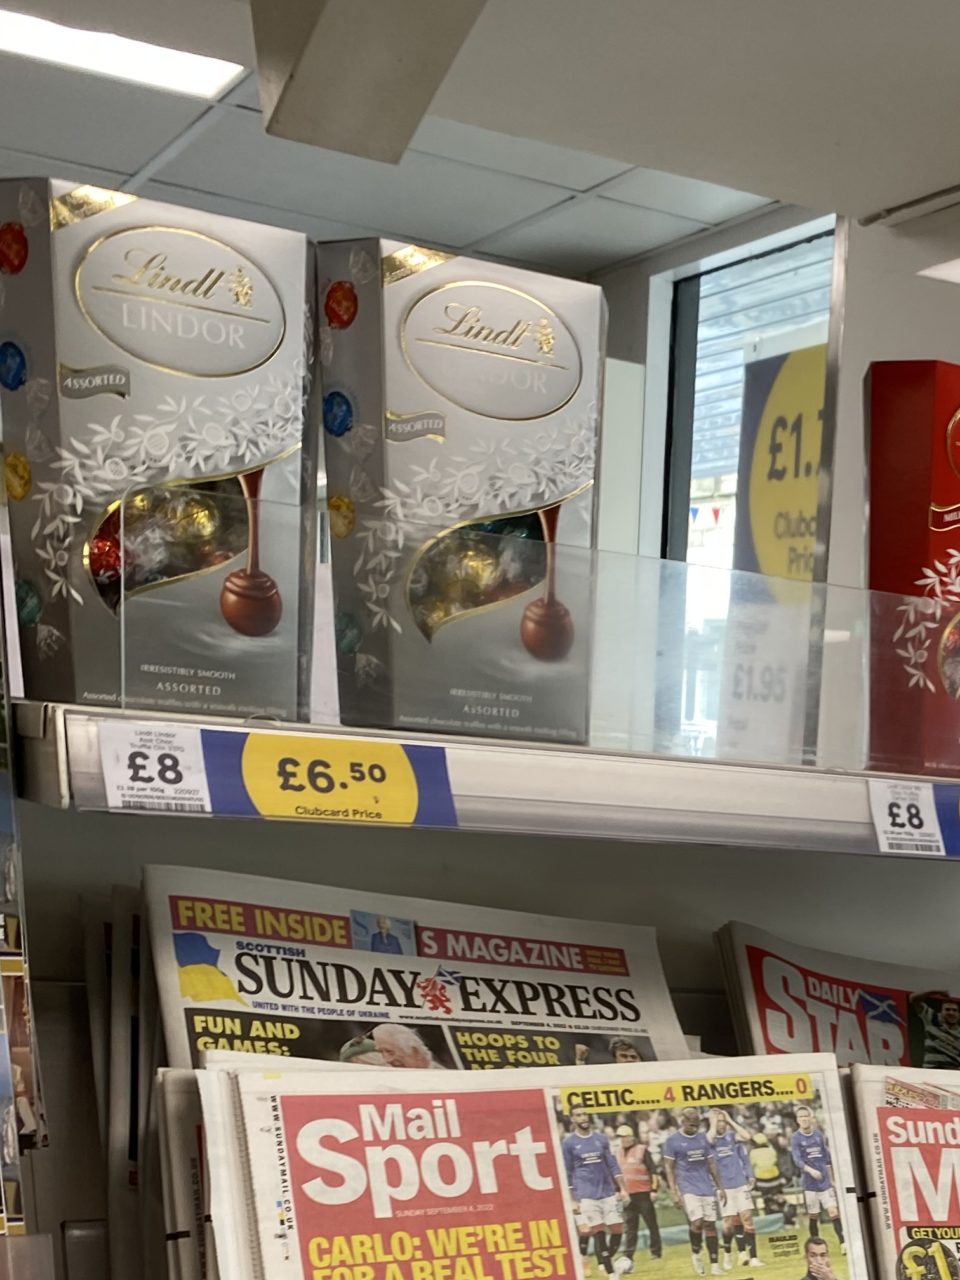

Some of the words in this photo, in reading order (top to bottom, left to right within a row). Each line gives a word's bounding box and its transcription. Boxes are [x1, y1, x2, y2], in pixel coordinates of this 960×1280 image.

[112, 247, 226, 300] Lindt
[122, 303, 245, 349] LINDOR
[432, 302, 532, 349] Lindt
[63, 374, 126, 389] ASSORTED
[140, 664, 195, 676] IRRESISTIBLY
[197, 668, 236, 680] SMOOTH
[156, 682, 222, 696] ASSORTED
[463, 704, 520, 718] ASSORTED
[127, 751, 183, 785] £8
[277, 757, 387, 794] £6.50
[295, 805, 349, 818] Clubcard
[352, 809, 382, 820] Price
[888, 802, 924, 830] £8
[176, 900, 246, 934] FREE
[254, 909, 348, 945] INSIDE
[235, 941, 306, 958] SCOTTISH
[421, 930, 438, 956] S
[447, 933, 584, 970] MAGAZINE
[234, 952, 424, 1009] SUNDAY
[460, 976, 641, 1022] EXPRESS
[808, 980, 858, 1011] DAILY
[252, 1000, 280, 1011] UNITED
[281, 1003, 300, 1013] WITH
[302, 1006, 316, 1015] THE
[317, 1007, 346, 1017] PEOPLE
[347, 1009, 356, 1018] OF
[358, 1010, 390, 1020] UKRAINE
[762, 955, 905, 1067] STAR
[193, 1015, 242, 1036] FUN
[250, 1021, 300, 1040] AND
[358, 1099, 462, 1141] Mail
[296, 1118, 555, 1219] Sport
[308, 1230, 423, 1269] CARLO:
[427, 1223, 526, 1258] WE'RE
[531, 1219, 563, 1250] IN
[911, 1226, 935, 1239] GET
